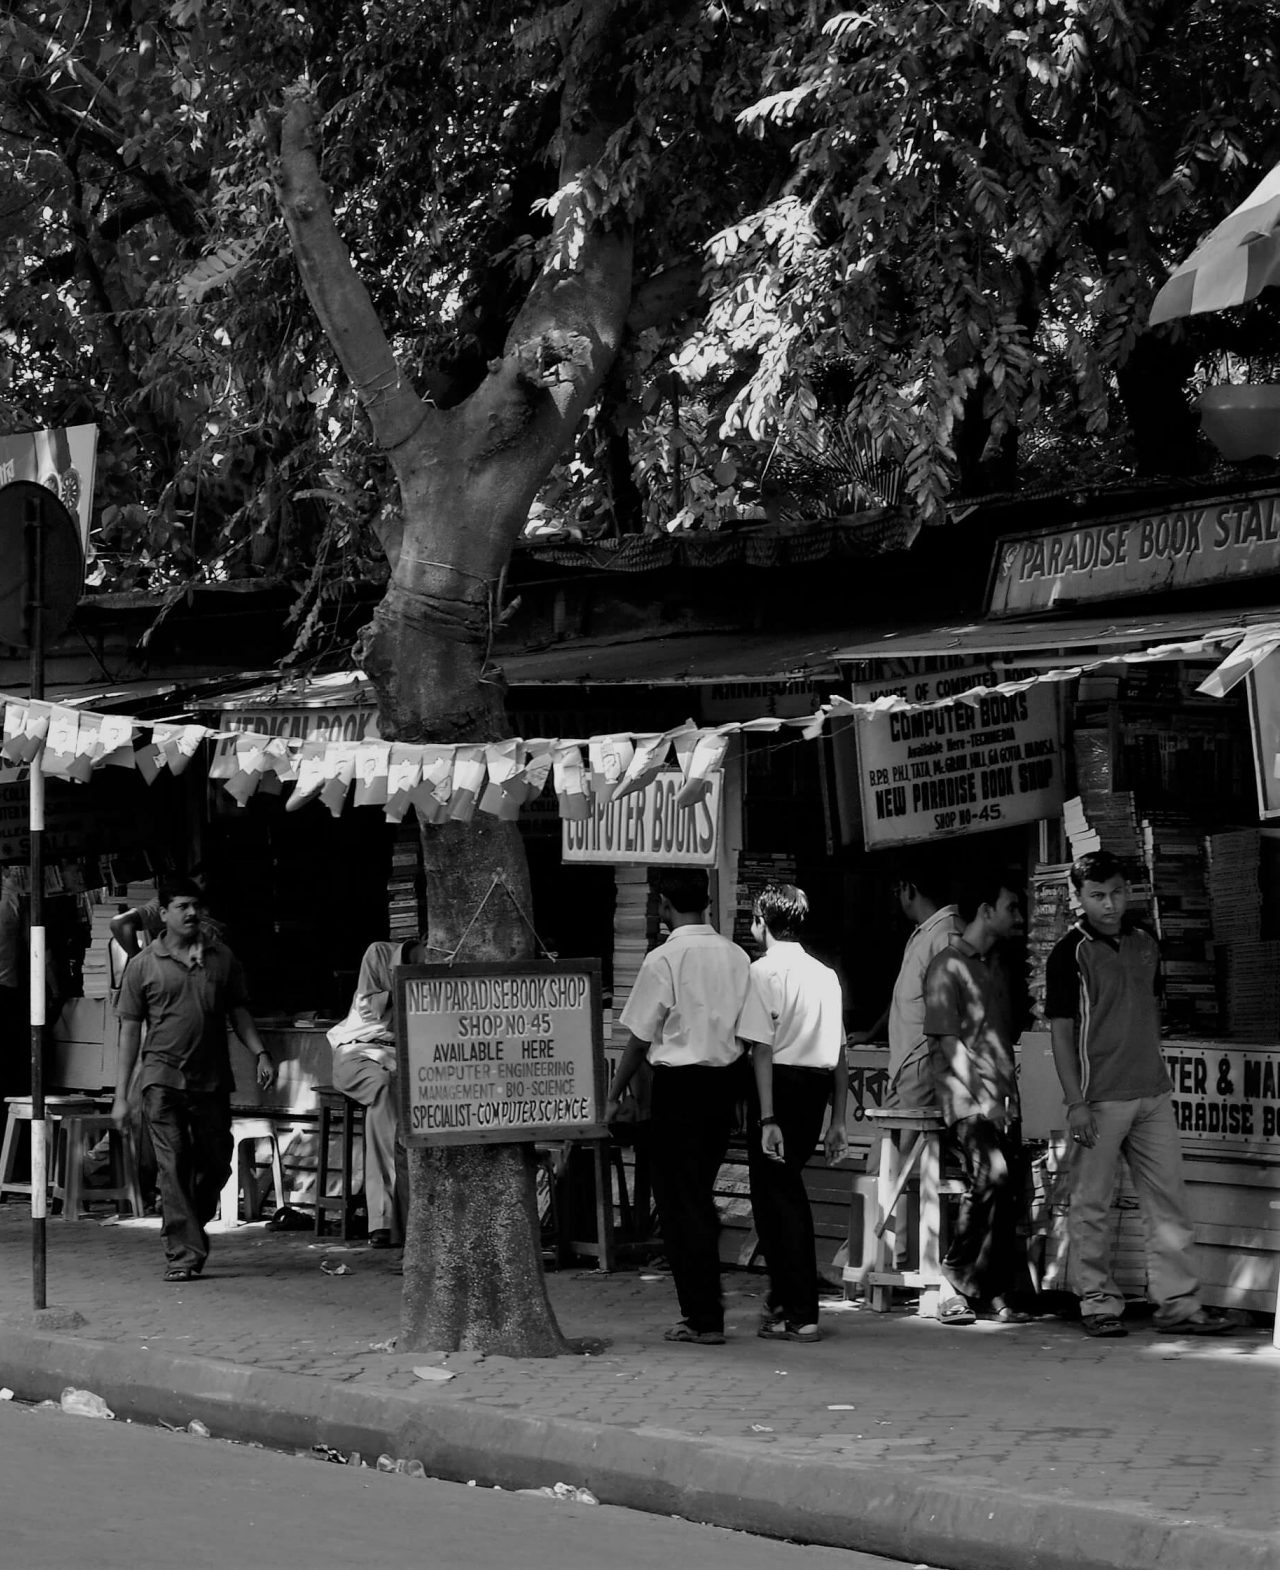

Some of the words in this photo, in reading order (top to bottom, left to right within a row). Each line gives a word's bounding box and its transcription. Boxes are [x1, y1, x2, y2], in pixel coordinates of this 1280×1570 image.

[1020, 525, 1132, 582] PARADISE
[1138, 510, 1206, 563] BOOK
[915, 682, 929, 701] OF
[936, 671, 997, 698] COMPUTER
[318, 713, 381, 741] BOOK
[889, 699, 975, 741] COMPUTER
[979, 691, 1028, 728] BOOKS
[876, 785, 907, 820] NEW
[912, 772, 977, 813] PARADISE
[981, 765, 1014, 800] BOOK
[1018, 758, 1054, 793] SHOP
[652, 779, 714, 854] BOOKS
[934, 813, 957, 830] SHOP
[408, 982, 443, 1014] NEW
[548, 976, 587, 1009] SHOP
[458, 1015, 503, 1038] SHOP
[433, 1041, 504, 1062] AVAILABLE
[521, 1039, 555, 1060] HERE
[418, 1083, 496, 1101] MANAGEMENT
[1216, 1058, 1234, 1096] &
[1244, 1060, 1280, 1099] MA
[1171, 1099, 1254, 1136] RADISE
